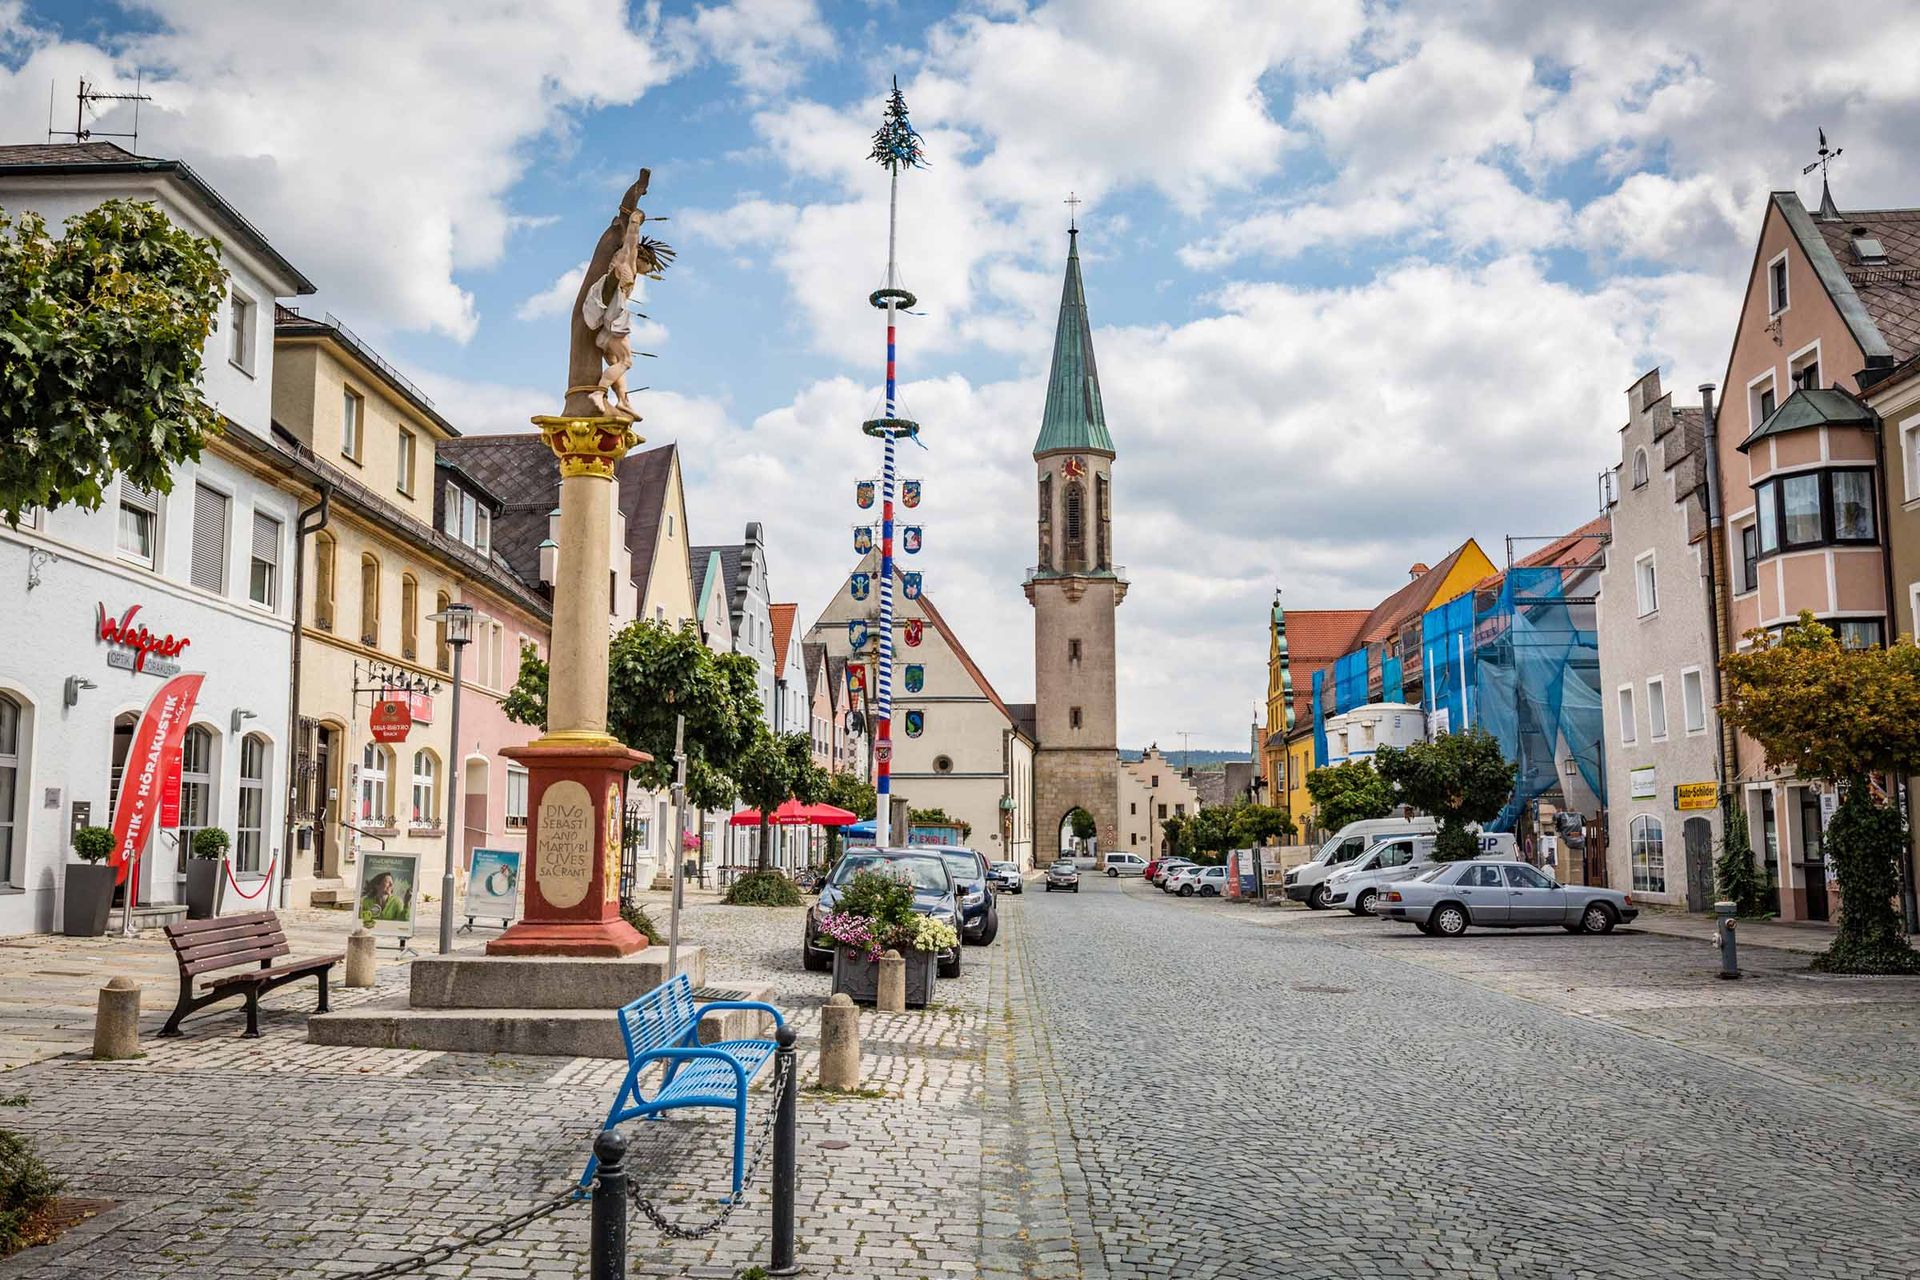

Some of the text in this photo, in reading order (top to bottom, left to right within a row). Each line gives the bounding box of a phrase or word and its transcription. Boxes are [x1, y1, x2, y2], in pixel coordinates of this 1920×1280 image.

[98, 601, 190, 672] Wagner
[110, 652, 131, 666] OPTIK
[122, 813, 143, 861] OPTIK
[138, 694, 179, 797] HÖRAKUSTIK
[1679, 785, 1715, 798] Auto-Schilder
[546, 804, 583, 818] DIVO
[542, 817, 587, 829] SEBASTI
[552, 831, 578, 840] ANO
[546, 852, 585, 866] CIVES
